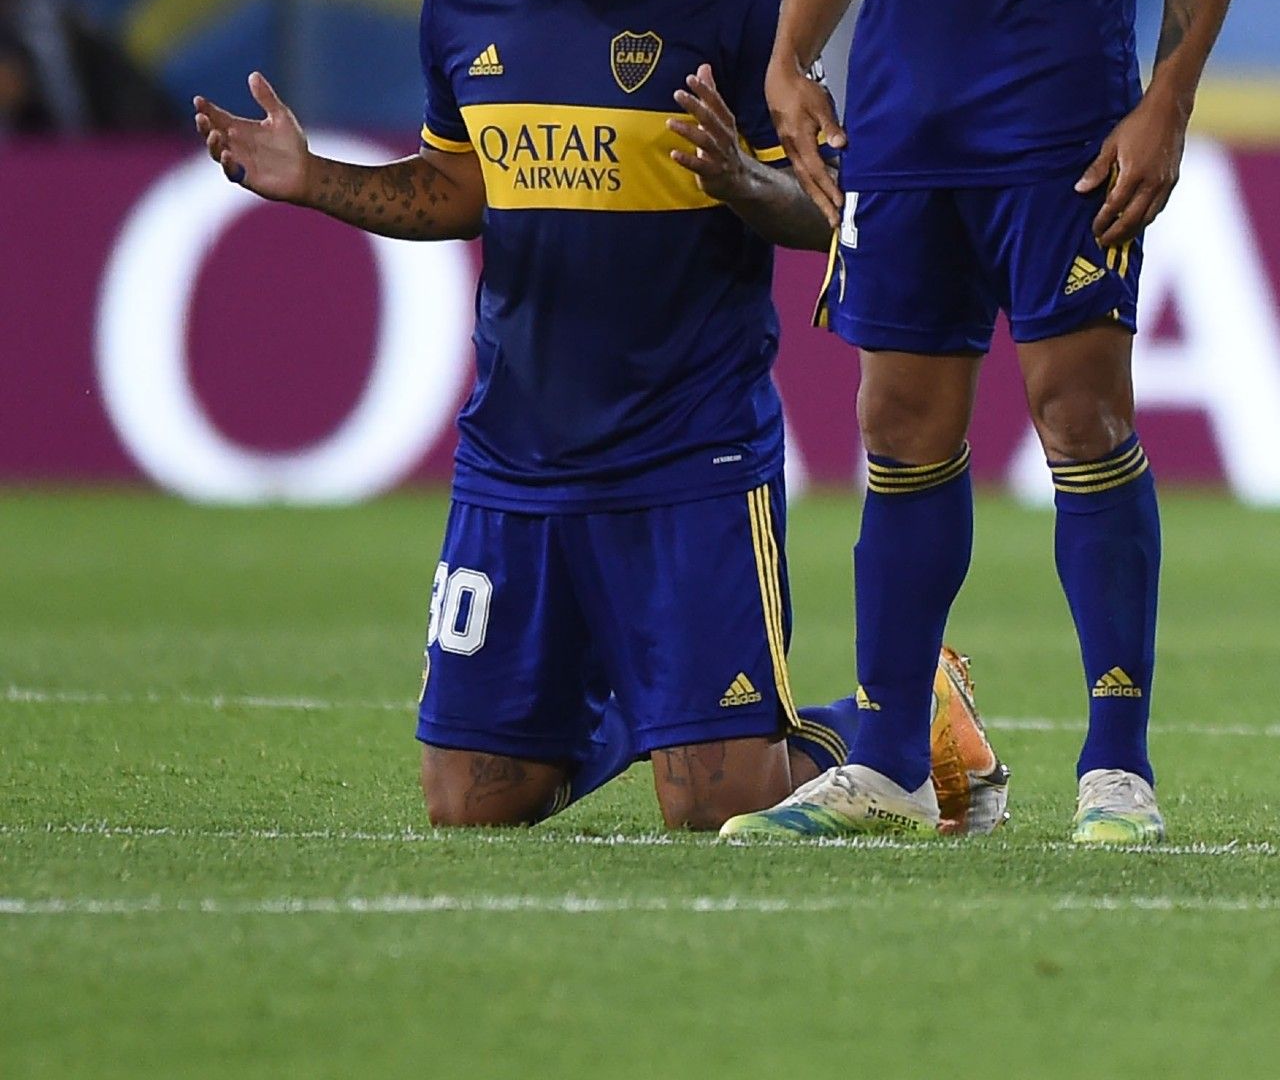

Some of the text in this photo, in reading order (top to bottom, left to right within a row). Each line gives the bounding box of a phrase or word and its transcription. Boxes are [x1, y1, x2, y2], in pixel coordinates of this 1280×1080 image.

[616, 51, 653, 65] CABJ
[479, 124, 619, 171] QATAR
[513, 167, 621, 191] AIRWAYS
[1064, 268, 1106, 295] adidas
[719, 689, 762, 708] adidas
[1092, 685, 1142, 698] adidas
[866, 805, 919, 830] NEMESIS
